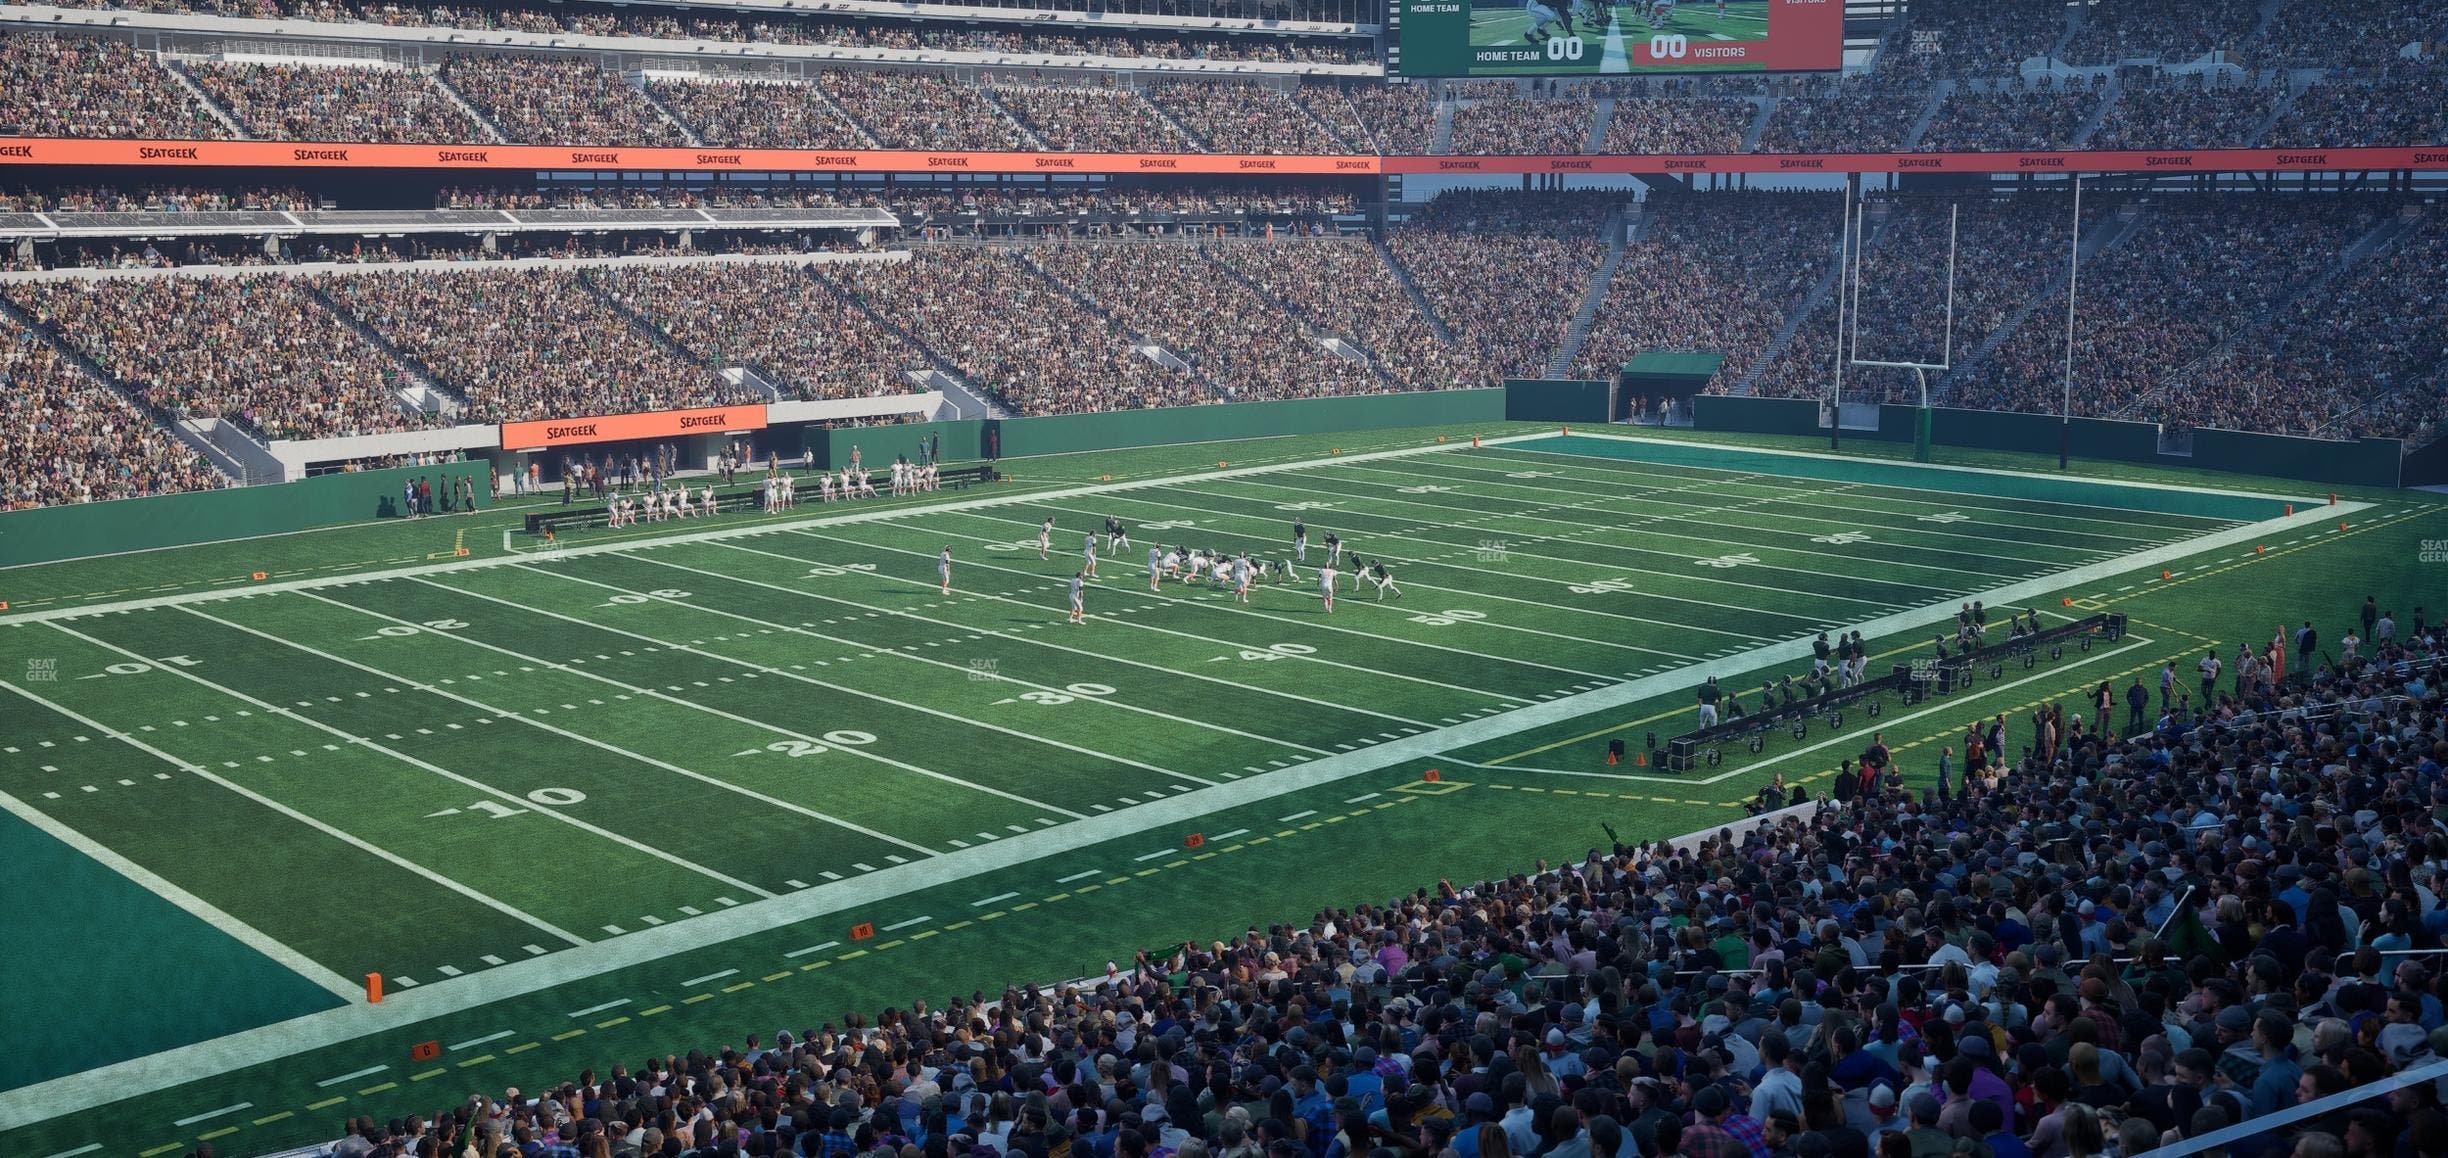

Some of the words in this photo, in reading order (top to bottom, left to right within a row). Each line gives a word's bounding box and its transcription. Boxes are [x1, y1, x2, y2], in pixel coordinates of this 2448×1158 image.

[1410, 4, 1436, 13] HOME
[1436, 4, 1460, 13] TEAM
[1476, 52, 1508, 61] HOME
[1510, 51, 1540, 61] TEAM
[1547, 36, 1583, 60] 00
[1650, 34, 1687, 58] 00
[1694, 47, 1746, 57] VISITORS
[0, 145, 33, 158] GEEK
[140, 147, 198, 160] SEATGEEK
[293, 149, 348, 161] SEATGEEK
[438, 151, 488, 162] SEATGEEK
[571, 153, 618, 164] SEATGEEK
[696, 154, 741, 165] SEATGEEK
[815, 155, 857, 166] SEATGEEK
[928, 157, 968, 167] SEATGEEK
[1035, 158, 1074, 168] SEATGEEK
[1139, 159, 1176, 168] SEATGEEK
[1780, 159, 1823, 168] SEATGEEK
[1898, 158, 1942, 168] SEATGEEK
[2019, 157, 2065, 167] SEATGEEK
[2146, 156, 2193, 166] SEATGEEK
[2276, 155, 2327, 164] SEATGEEK
[1239, 160, 1276, 169] SEATGEEK
[1336, 161, 1370, 169] SEATGEEK
[1439, 161, 1480, 170] SEATGEEK
[1551, 161, 1592, 169] SEATGEEK
[1664, 160, 1706, 169] SEATGEEK
[680, 413, 726, 429] SEATGEEK
[547, 424, 597, 440] SEATGEEK
[1405, 609, 1488, 626] 50
[1238, 643, 1318, 661] 40
[1019, 683, 1117, 705] 30
[766, 730, 877, 757] 20
[466, 787, 587, 819] 10
[859, 926, 868, 937] 10
[423, 1045, 431, 1056] G
